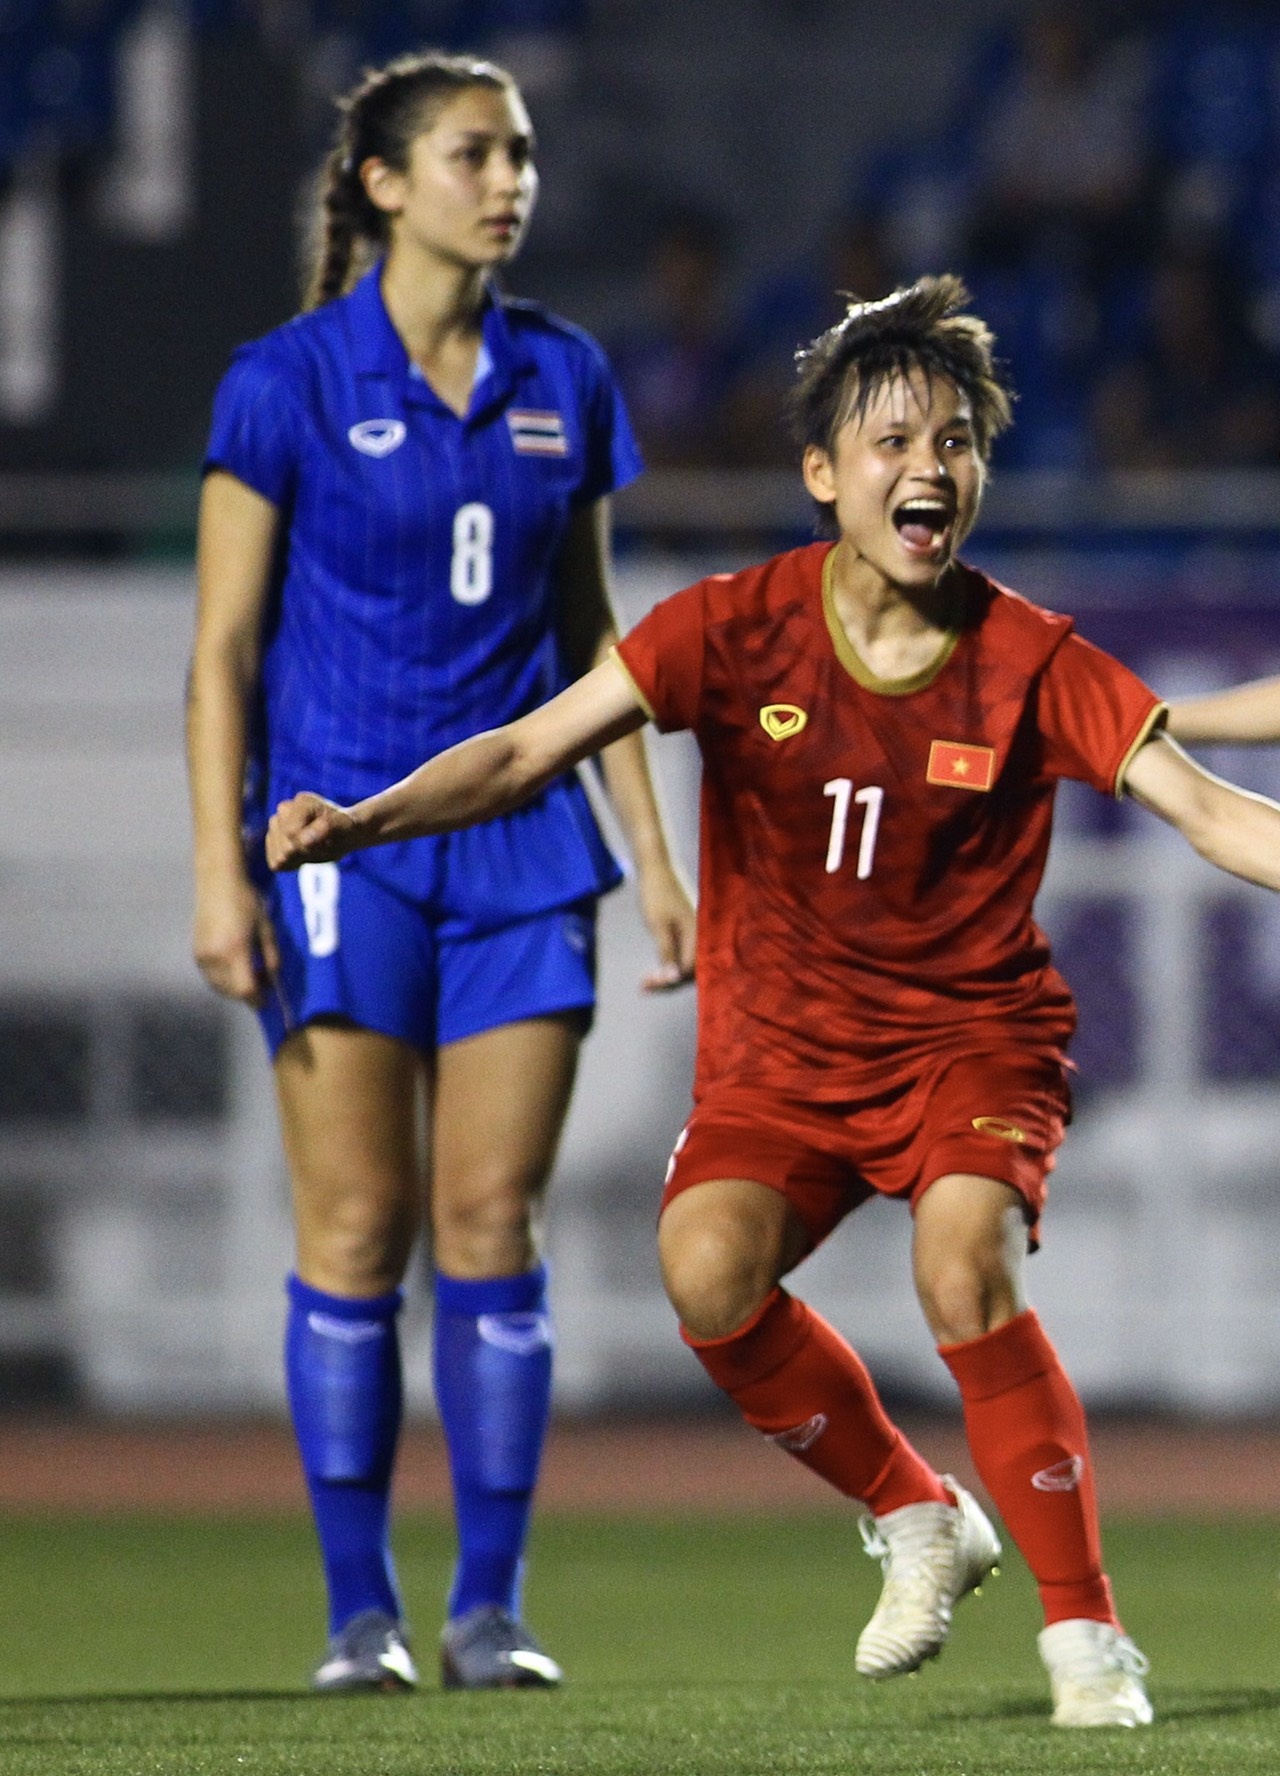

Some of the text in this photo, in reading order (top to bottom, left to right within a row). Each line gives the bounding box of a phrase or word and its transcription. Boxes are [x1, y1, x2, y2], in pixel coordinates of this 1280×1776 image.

[451, 502, 493, 606] 8
[823, 777, 884, 880] 11
[298, 862, 340, 958] 8
